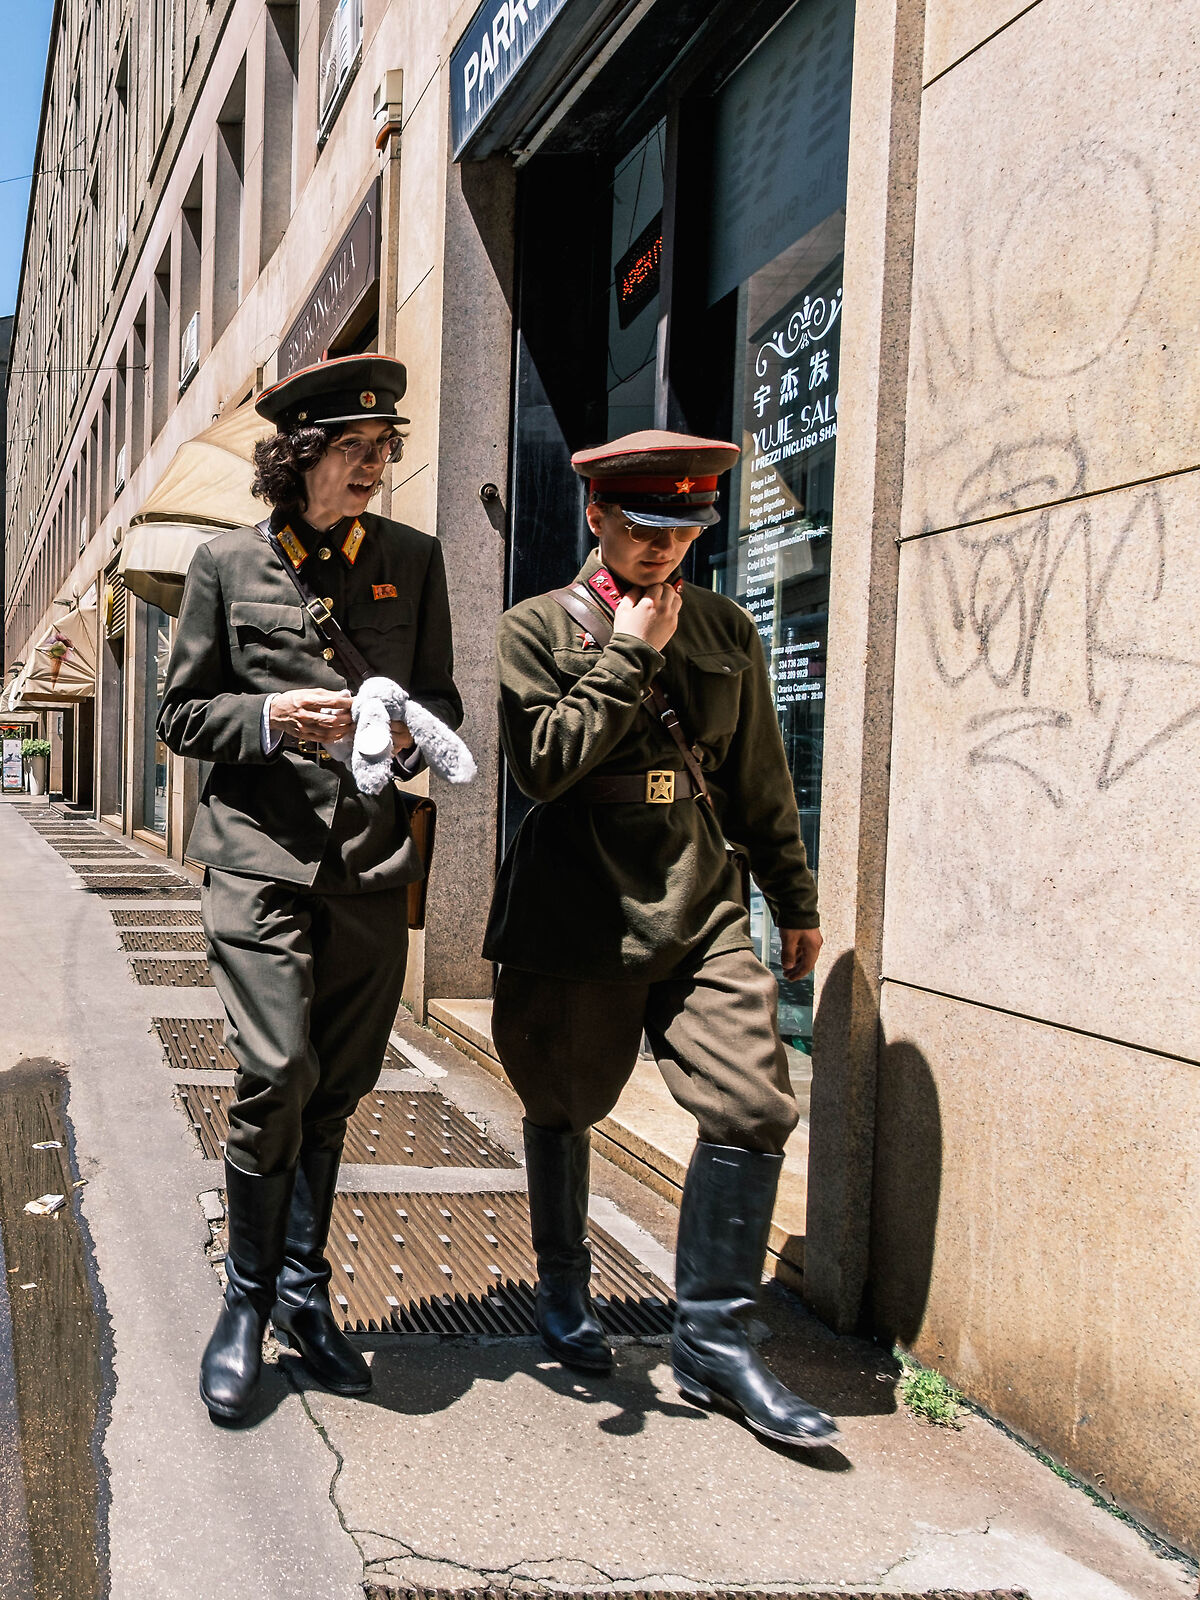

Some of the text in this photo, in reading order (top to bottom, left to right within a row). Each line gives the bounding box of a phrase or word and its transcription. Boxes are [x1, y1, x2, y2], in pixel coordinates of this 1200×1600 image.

[752, 414, 793, 456] YUJIE
[756, 448, 782, 471] PREZZI
[783, 431, 817, 459] INCLUSO
